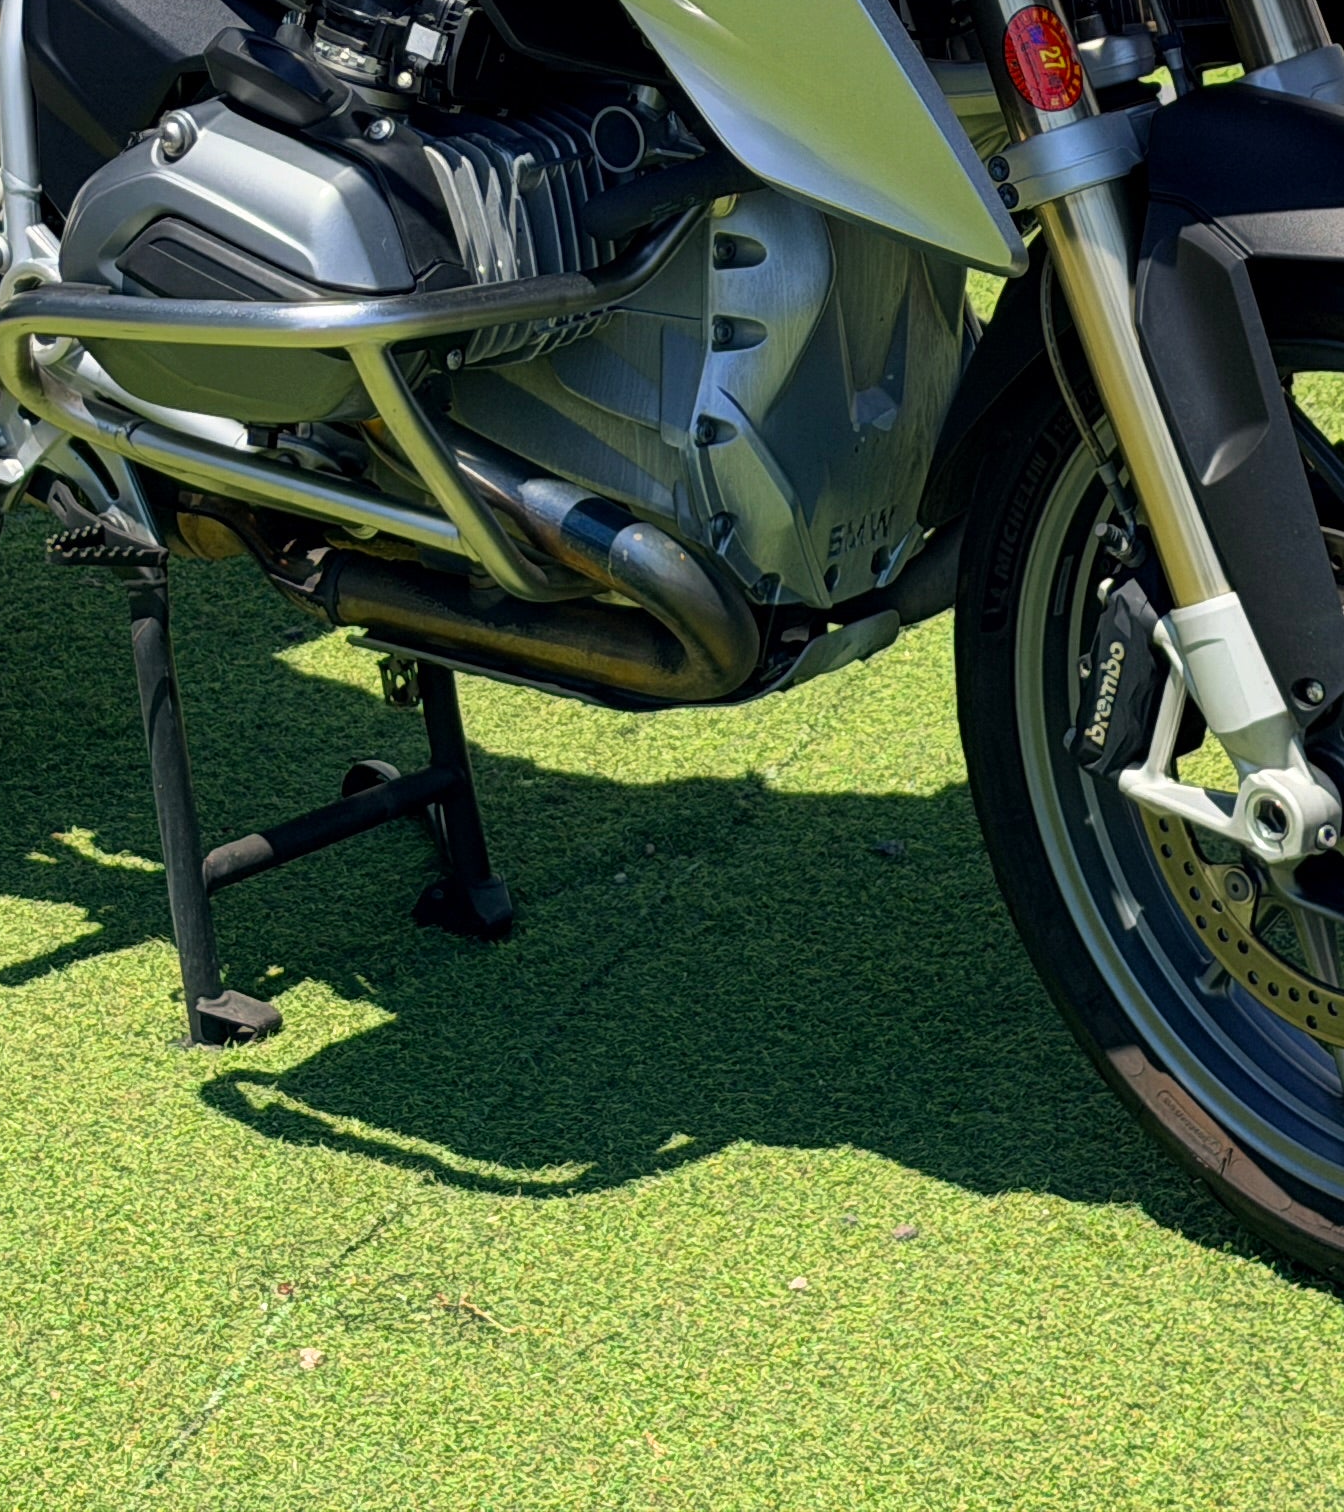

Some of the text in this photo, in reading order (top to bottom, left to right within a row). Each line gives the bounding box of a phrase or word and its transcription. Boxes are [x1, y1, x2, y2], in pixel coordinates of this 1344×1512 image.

[1039, 46, 1066, 69] 27
[827, 505, 897, 559] BMW
[1084, 641, 1125, 746] brembo
